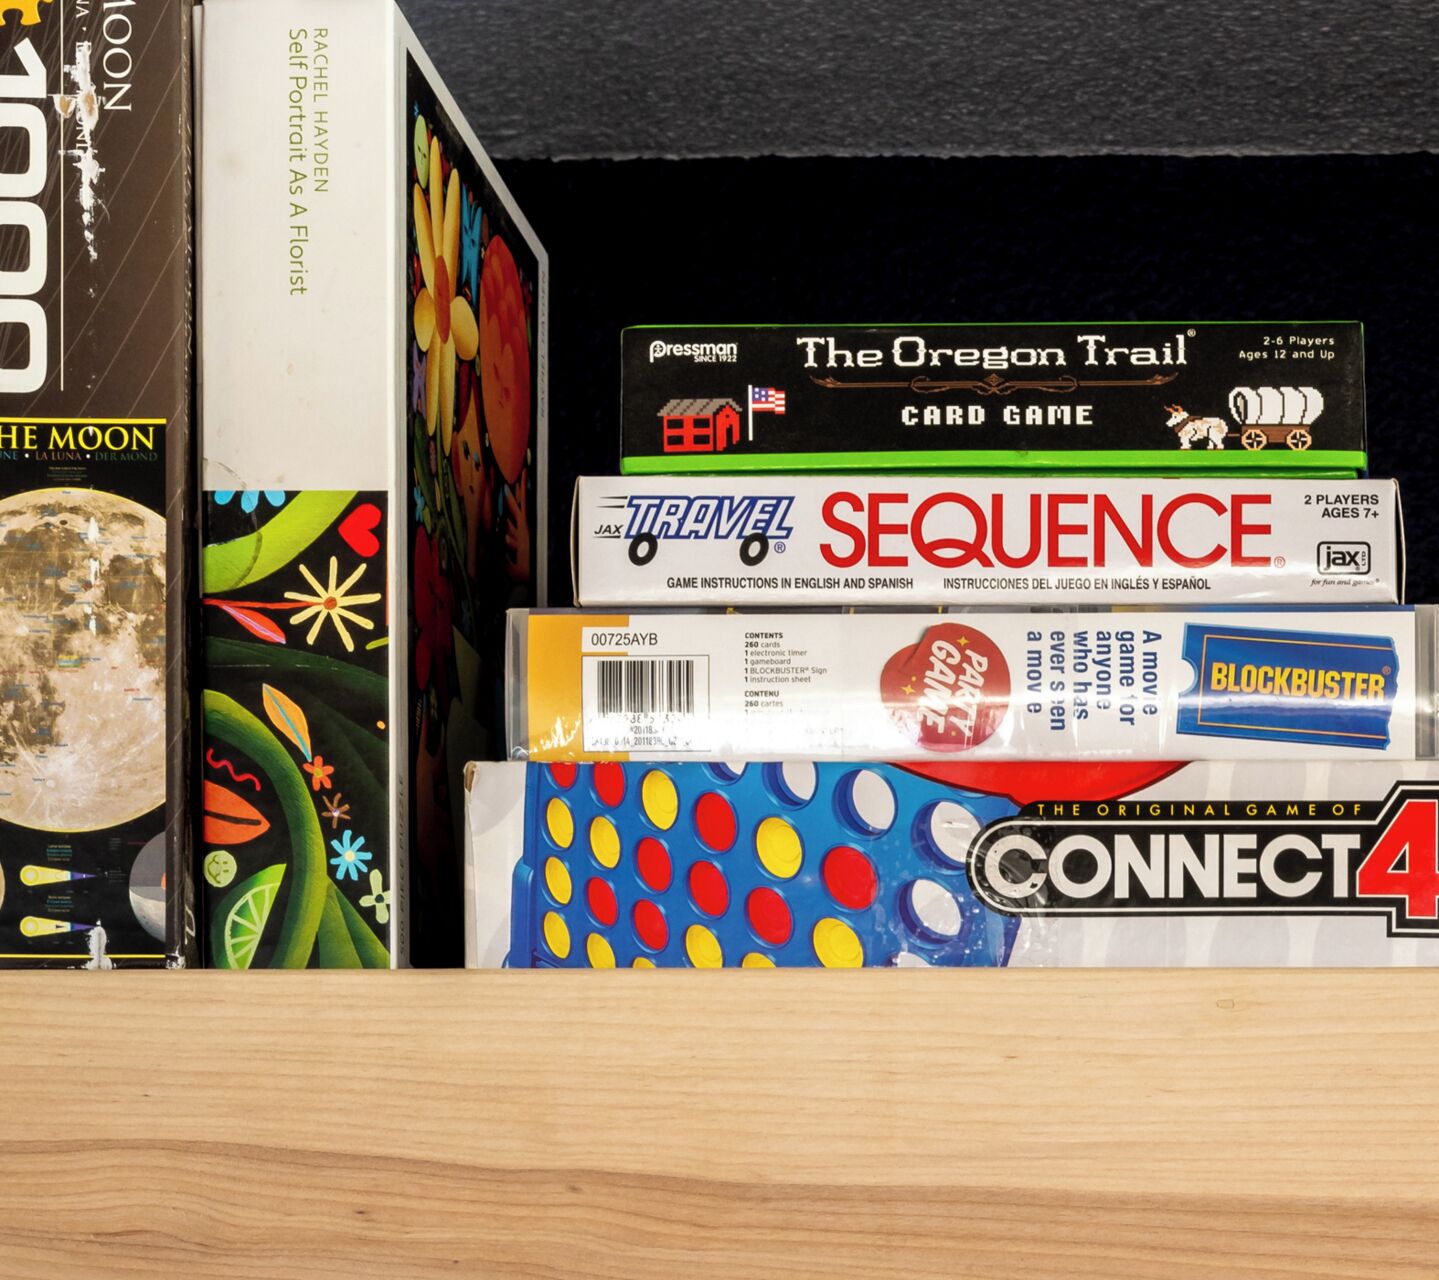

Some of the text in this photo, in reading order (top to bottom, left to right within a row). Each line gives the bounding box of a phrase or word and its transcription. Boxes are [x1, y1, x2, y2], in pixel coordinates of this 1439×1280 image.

[313, 27, 328, 192] RACHEL HAYDEN
[289, 28, 308, 295] Self Portrait As A Florist
[1263, 337, 1334, 346] 2-6 Players
[797, 337, 883, 368] The
[892, 336, 1066, 369] Oregon
[1239, 350, 1334, 359] Ages 12 and Up
[902, 406, 1093, 425] CARD GAME
[48, 426, 154, 450] MOON
[1305, 495, 1379, 504] 2 PLAYERS
[625, 496, 795, 539] TRAVEL
[1321, 508, 1379, 517] AGES 7+
[820, 491, 1272, 568] SEQUENCE
[667, 577, 913, 589] GAME INSTRUCTIONS IN ENGLISH AND SPANISH
[591, 633, 657, 646] 00725AYB
[1211, 662, 1385, 700] BLOCKBUSTER
[1038, 804, 1361, 816] THE ORIGINAL GAME OF
[986, 833, 1360, 898] CONNECT
